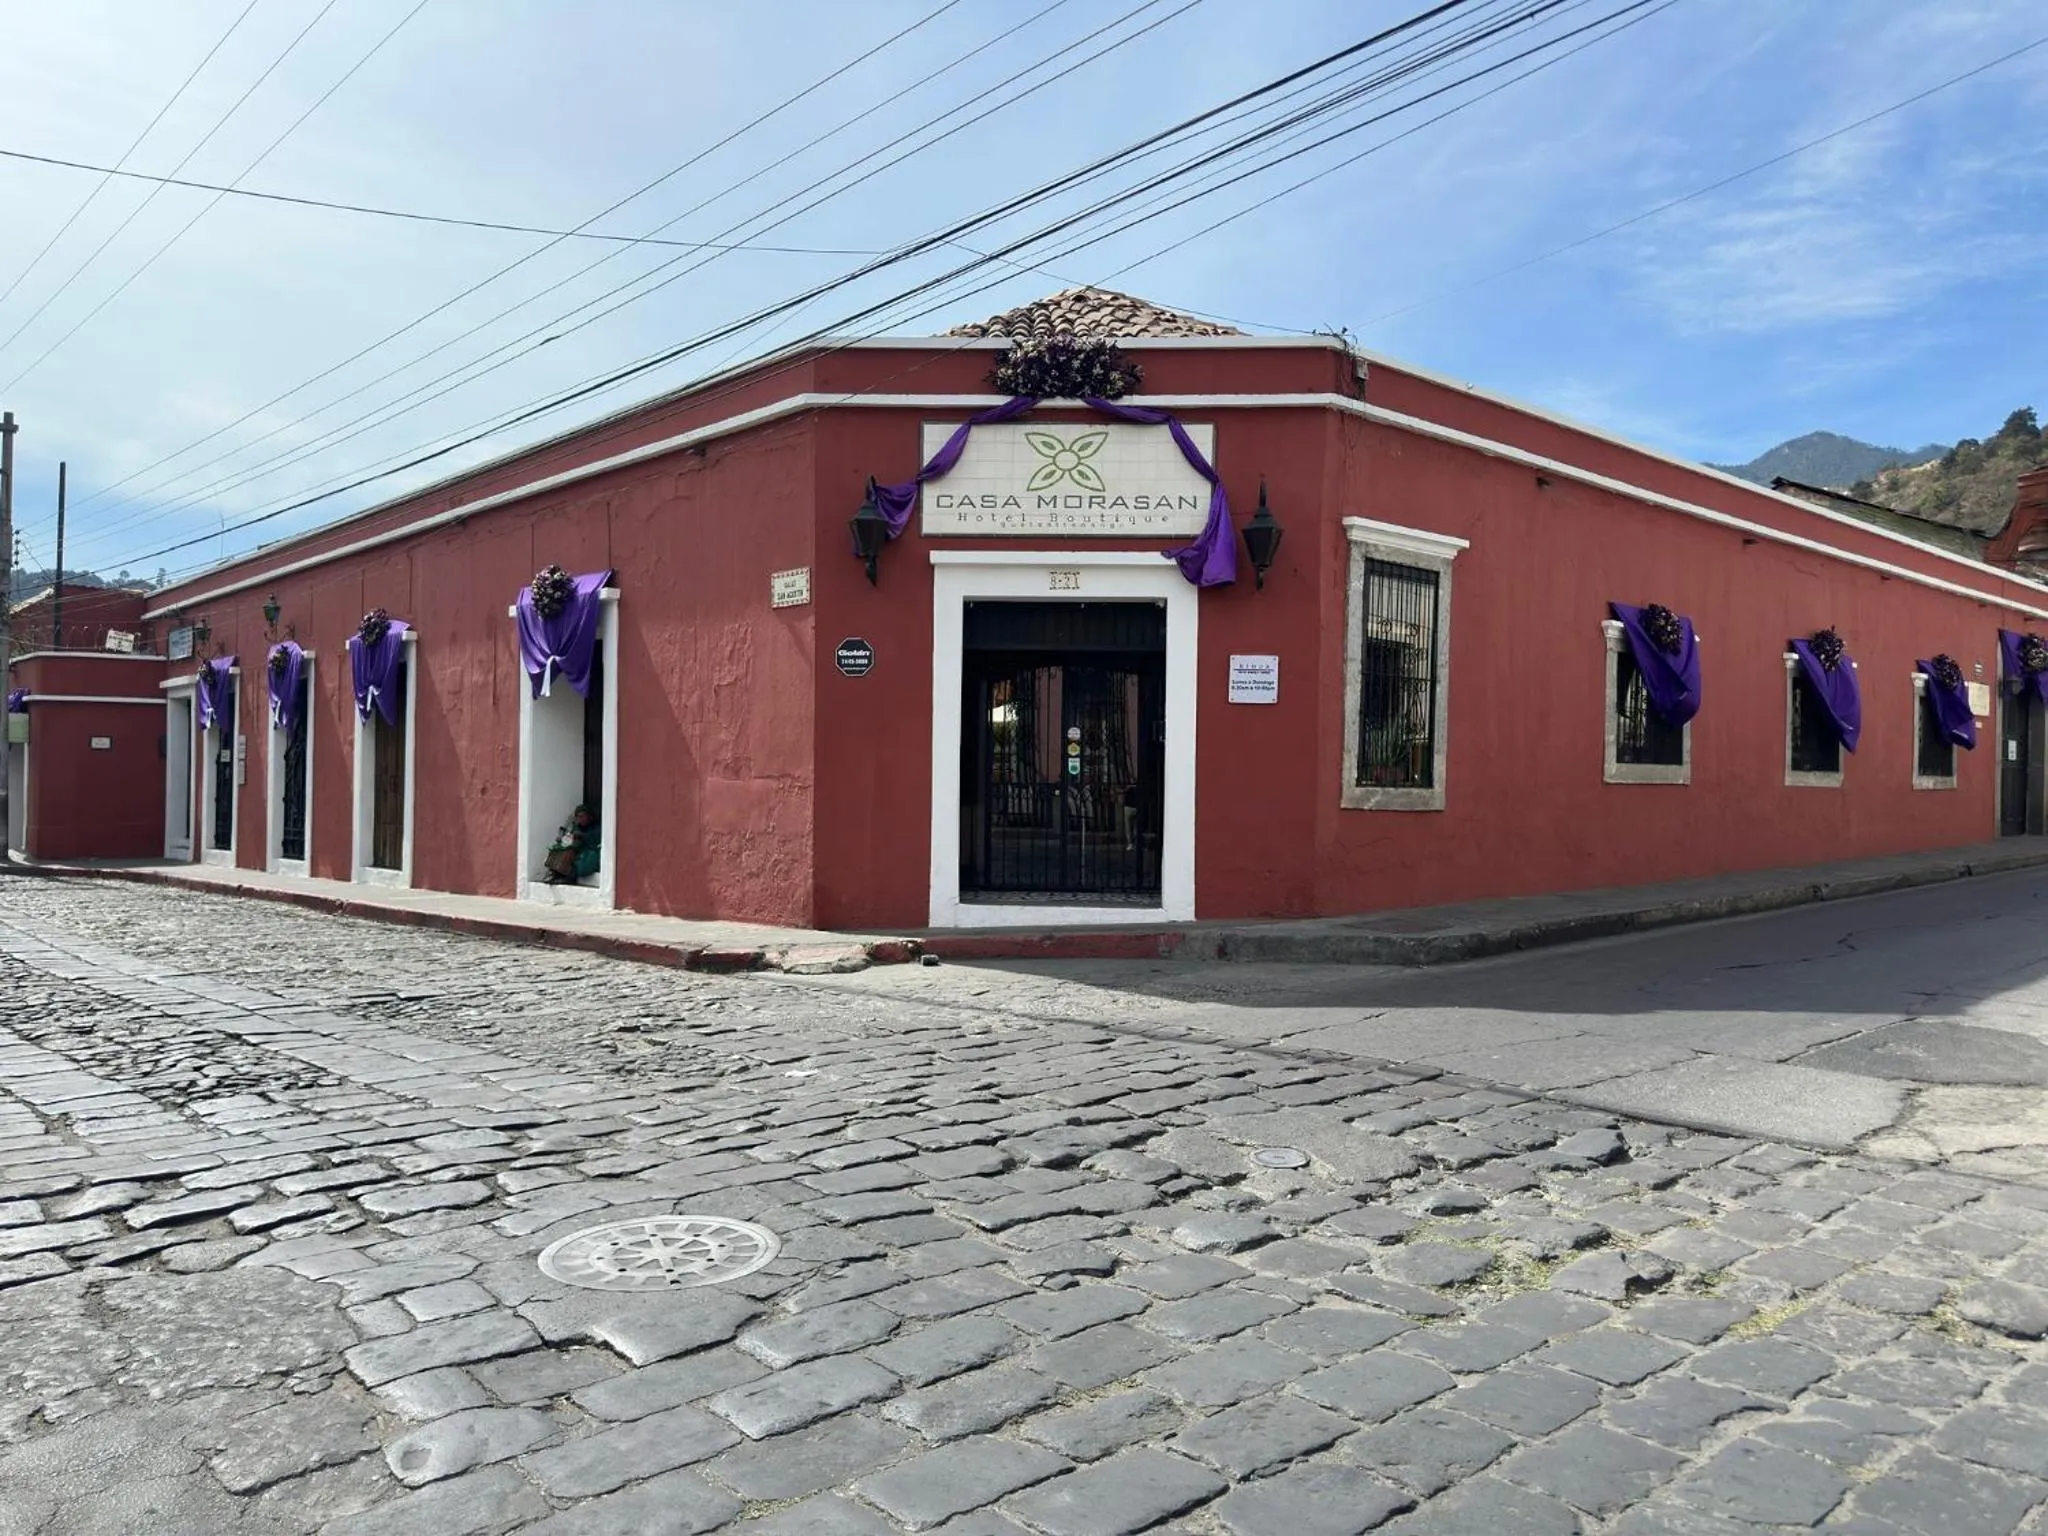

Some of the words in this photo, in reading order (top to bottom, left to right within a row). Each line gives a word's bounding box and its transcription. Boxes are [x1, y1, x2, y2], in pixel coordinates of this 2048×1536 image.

[936, 495, 1022, 509] CASA
[1037, 495, 1198, 510] MORASAN
[957, 512, 1026, 522] Hotel
[1050, 512, 1168, 525] Boutique
